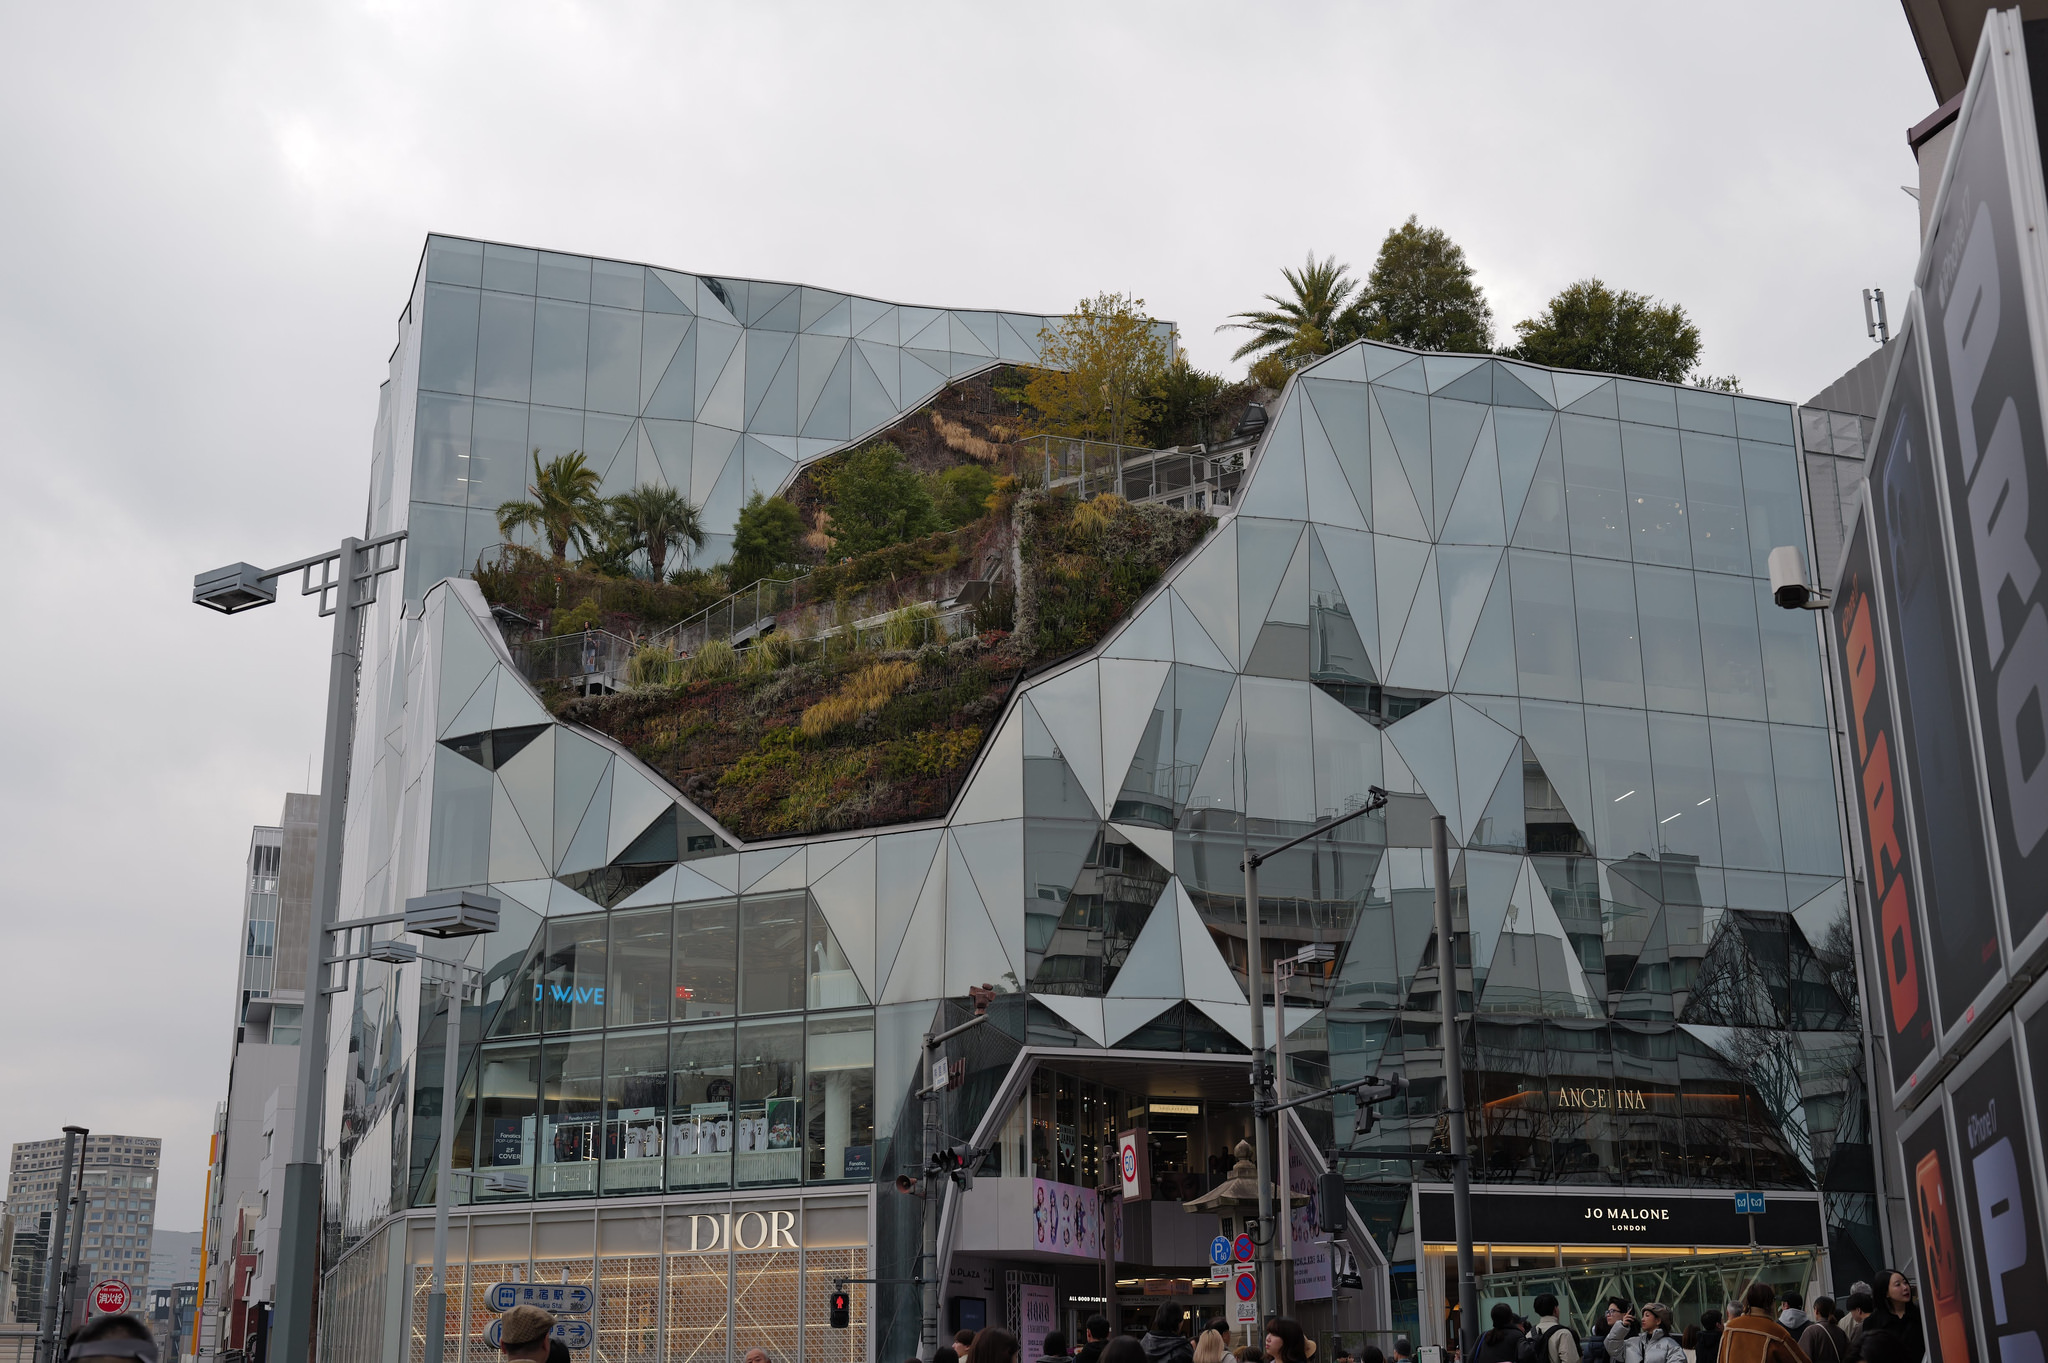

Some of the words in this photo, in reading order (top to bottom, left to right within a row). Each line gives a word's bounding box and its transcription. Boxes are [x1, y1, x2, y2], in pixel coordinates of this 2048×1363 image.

[1845, 591, 1919, 1035] PRO
[1124, 1155, 1134, 1172] 50
[1584, 1208, 1603, 1219] JO
[1607, 1208, 1670, 1220] MALONE
[688, 1210, 800, 1252] DIOR
[1214, 1243, 1223, 1261] P
[957, 1267, 980, 1278] PLAZA
[98, 1293, 124, 1305] 消火栓
[523, 1288, 564, 1301] 原宿駅
